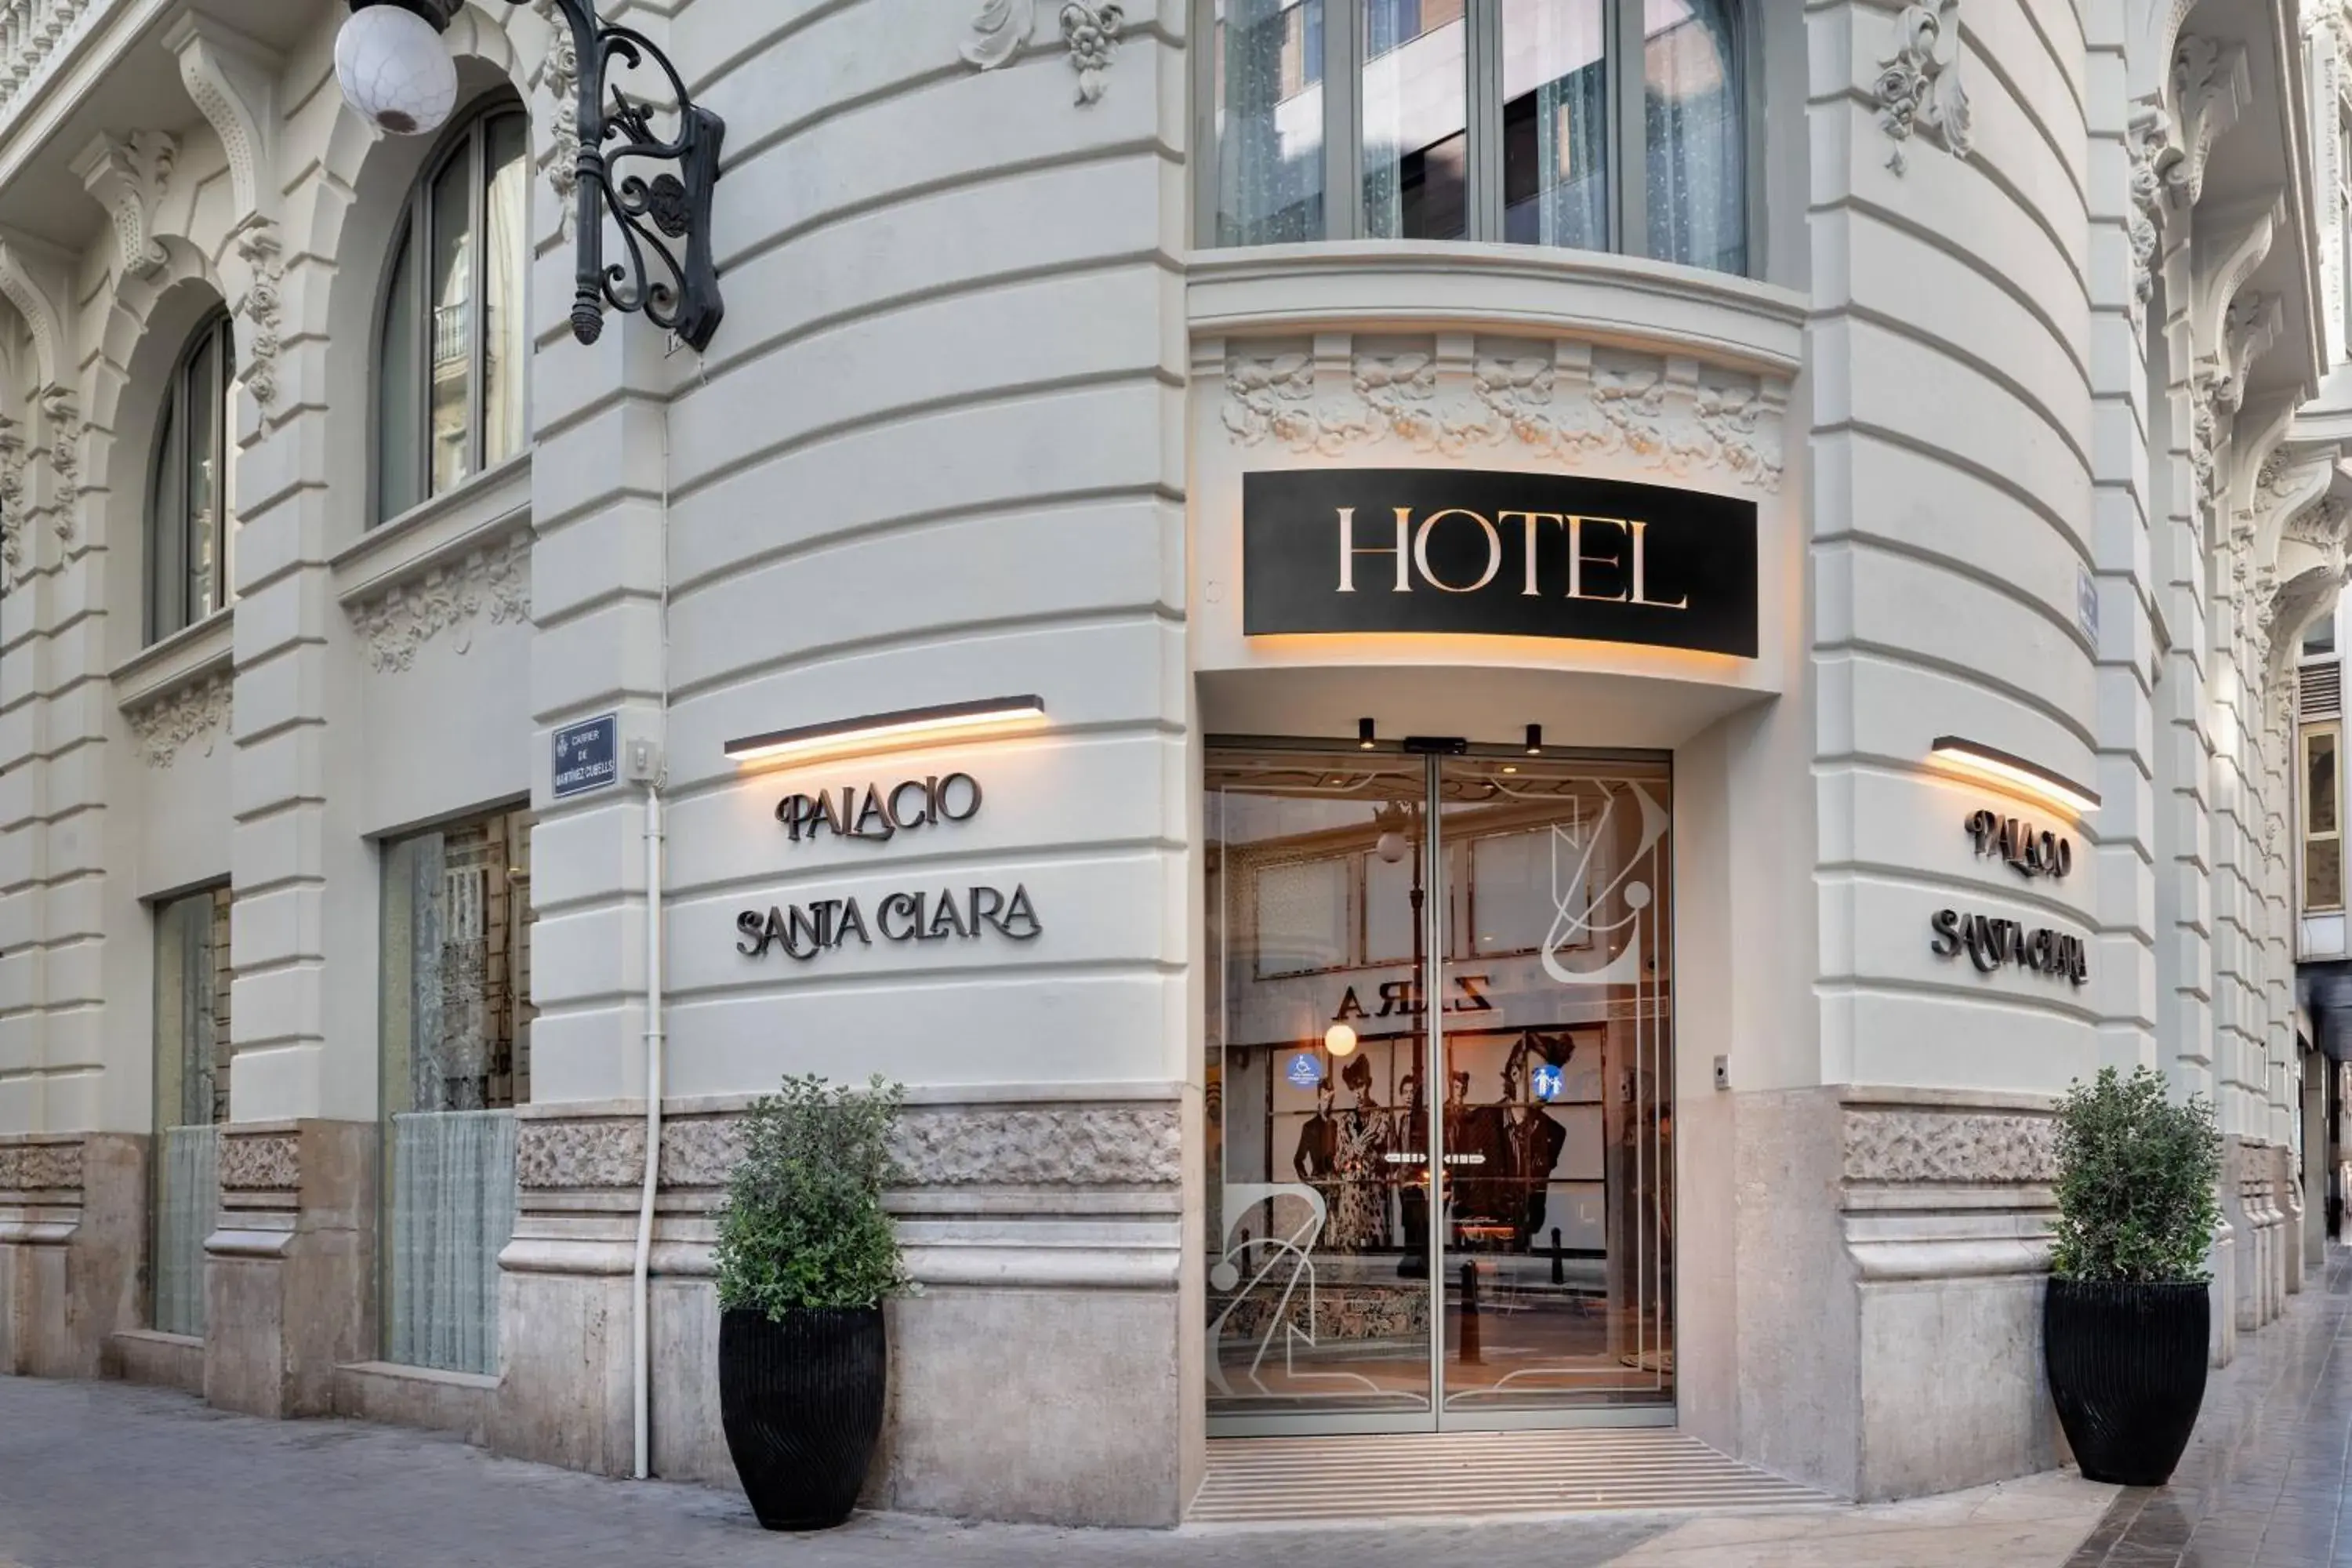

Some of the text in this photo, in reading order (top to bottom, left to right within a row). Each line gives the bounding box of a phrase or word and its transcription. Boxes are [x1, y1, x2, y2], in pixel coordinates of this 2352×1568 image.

[1335, 506, 1689, 609] HOTEL
[775, 772, 983, 841] PALACIO
[1964, 809, 2071, 878] PALACIO
[736, 883, 1044, 960] SANTA CLARA
[1931, 909, 2027, 972] SANTA
